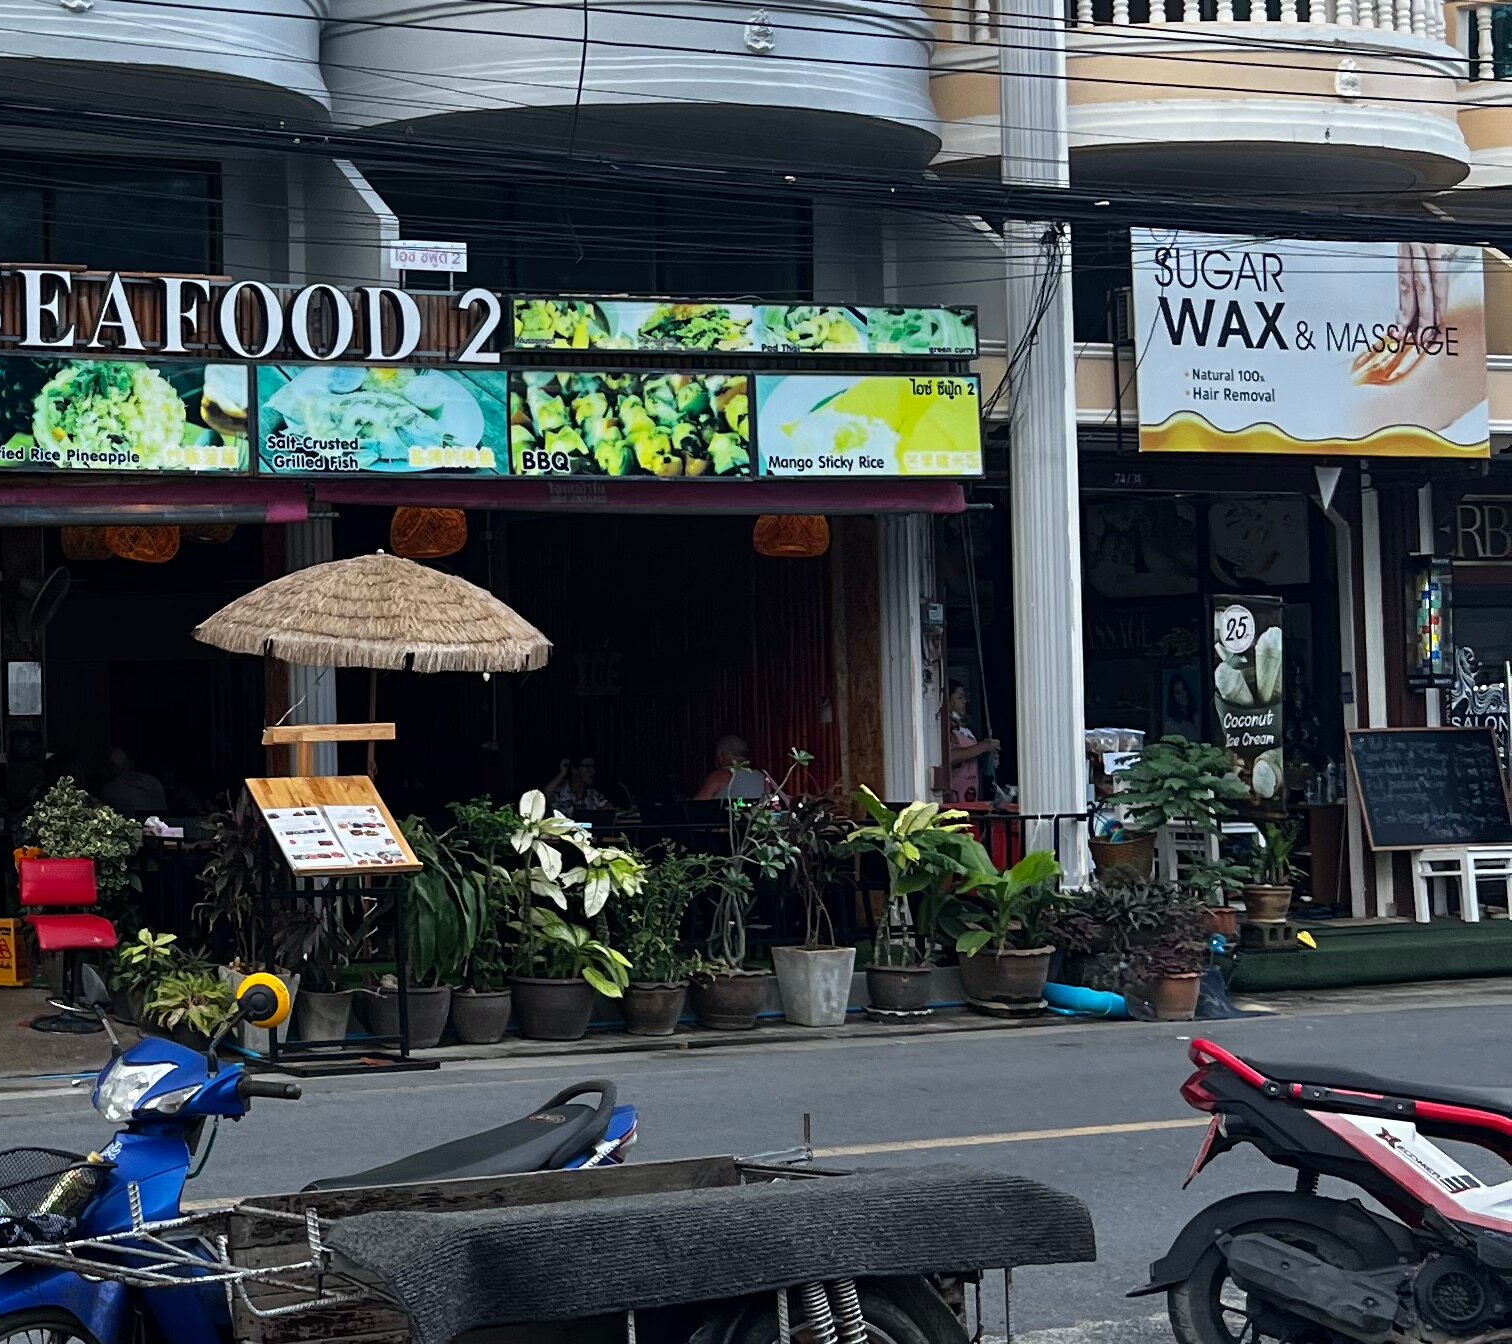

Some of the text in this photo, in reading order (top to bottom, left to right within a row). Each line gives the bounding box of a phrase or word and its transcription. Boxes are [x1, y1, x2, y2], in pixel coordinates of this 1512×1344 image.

[1154, 246, 1285, 293] SUGAR
[450, 288, 502, 364] 2
[1158, 296, 1459, 357] WAX & MASSAGE
[1192, 368, 1234, 381] Natural
[967, 382, 975, 395] 2
[1192, 387, 1275, 403] Hair Removal
[267, 436, 359, 451] Salt-Crusted
[31, 447, 61, 462] Rice
[66, 448, 140, 465] Pineapple
[274, 455, 359, 470] Grilled Fish
[522, 451, 571, 473] BBQ
[768, 455, 885, 472] Mango Sticky Rice
[1223, 709, 1274, 729] Coconut
[1226, 731, 1275, 747] Ice Cream
